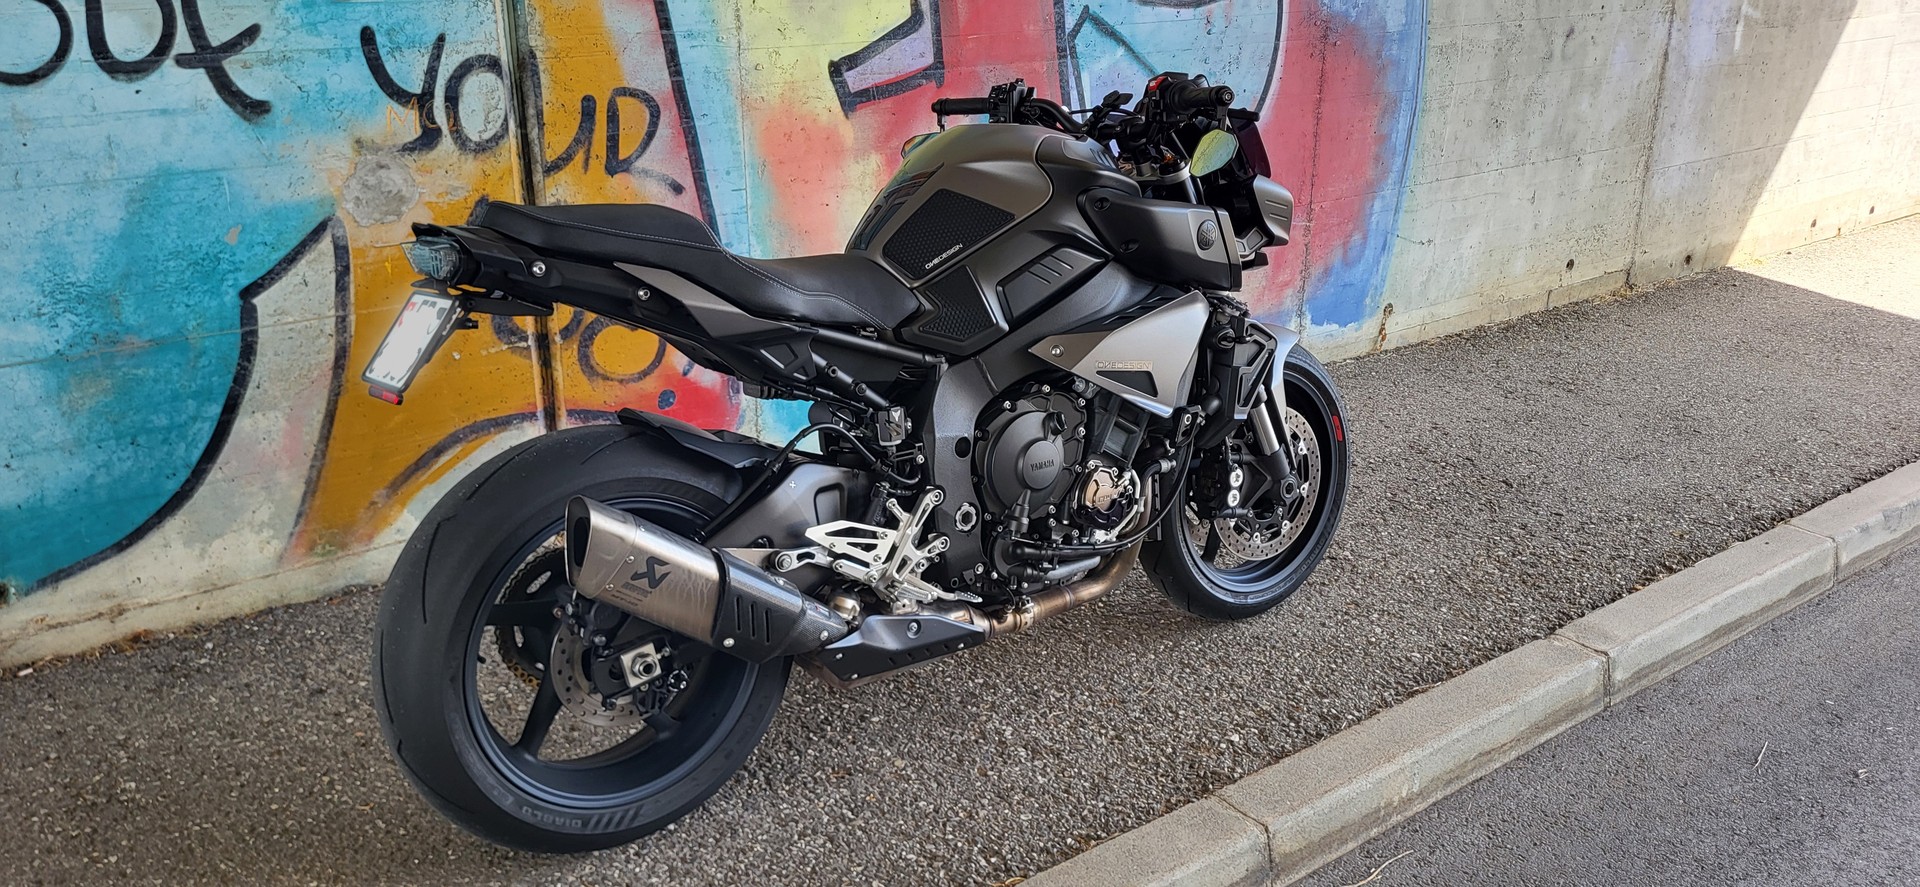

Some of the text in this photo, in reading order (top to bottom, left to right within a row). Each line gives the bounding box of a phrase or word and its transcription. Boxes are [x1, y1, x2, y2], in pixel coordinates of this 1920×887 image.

[925, 243, 963, 269] ONEDESIGN
[1097, 361, 1152, 370] ONEDESIGN
[1030, 459, 1055, 472] YAMAHA
[522, 805, 583, 828] DIABLO
